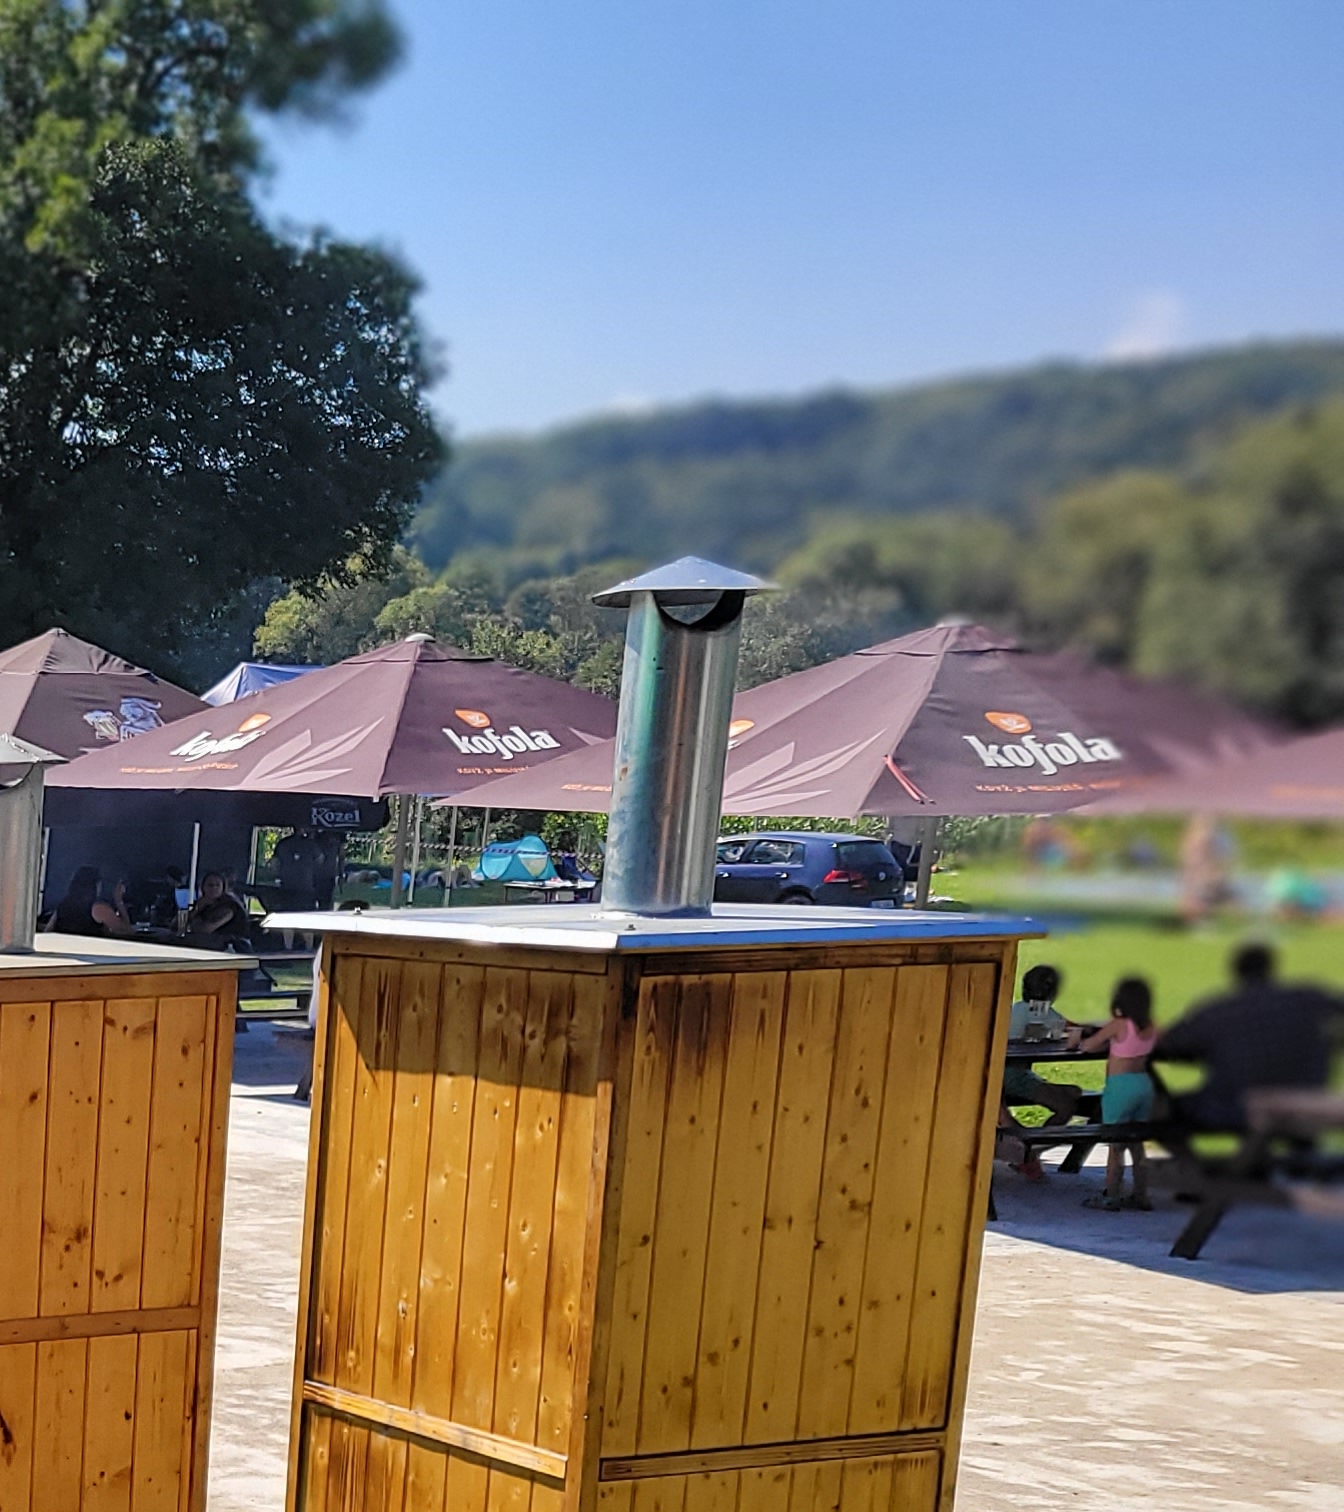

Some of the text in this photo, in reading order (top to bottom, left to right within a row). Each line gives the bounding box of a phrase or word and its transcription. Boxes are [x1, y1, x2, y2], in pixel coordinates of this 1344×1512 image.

[442, 725, 562, 760] kofola
[962, 732, 1124, 776] kofola
[311, 806, 361, 828] Kozel
